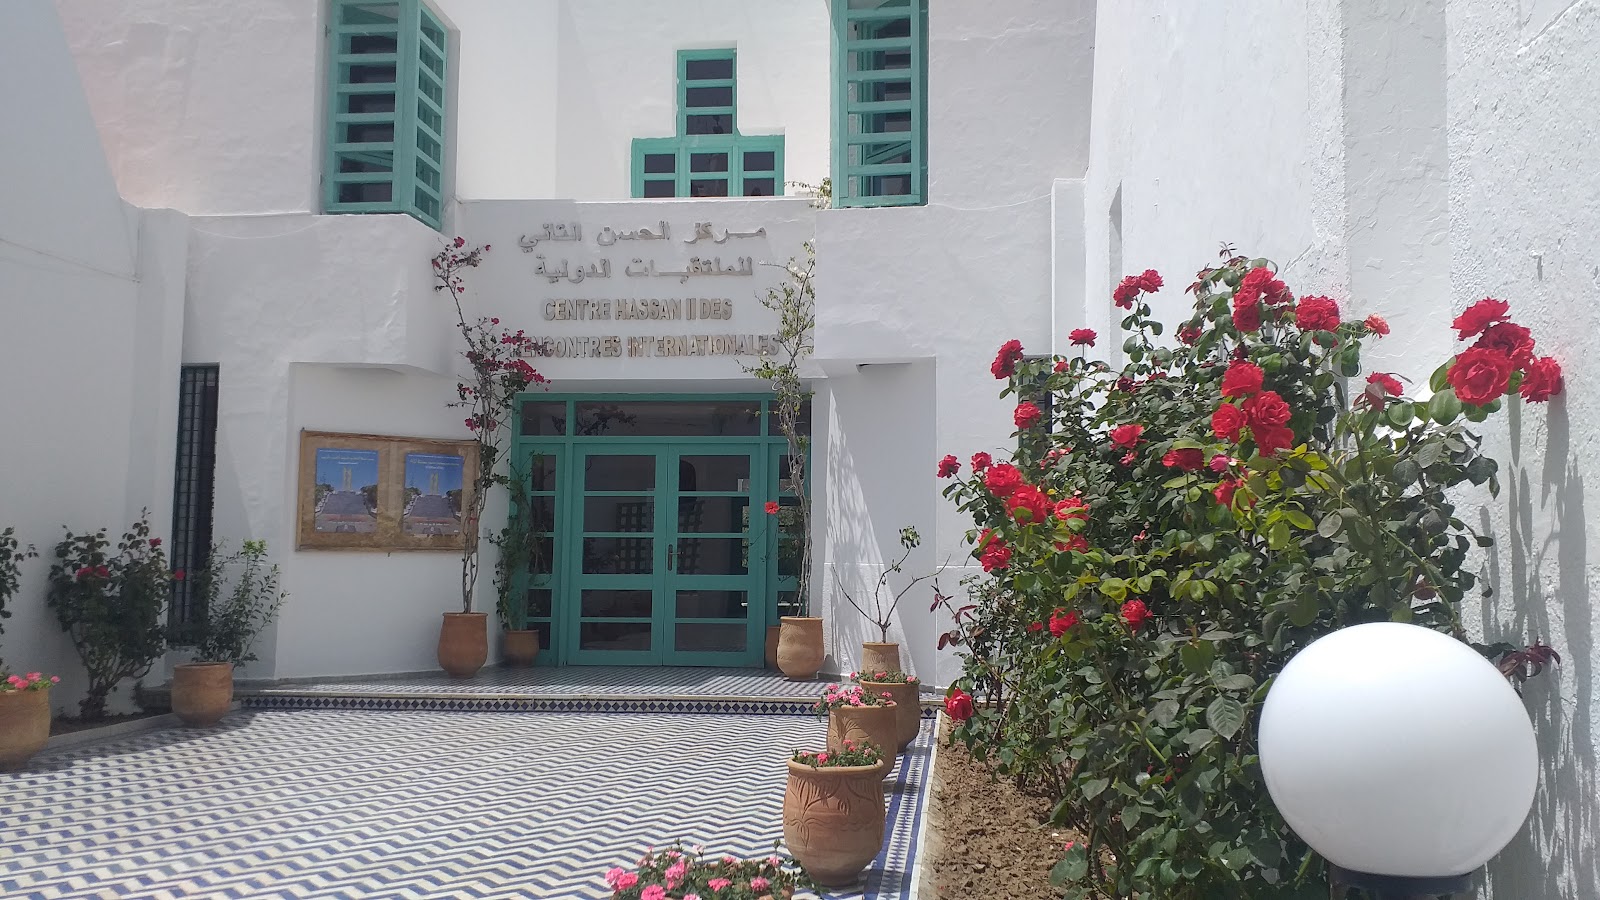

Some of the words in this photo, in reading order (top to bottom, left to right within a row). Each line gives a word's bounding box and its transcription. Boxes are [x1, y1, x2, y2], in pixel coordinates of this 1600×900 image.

[519, 223, 582, 254] الثاني
[597, 220, 671, 247] الحسن
[684, 221, 767, 245] مركز
[535, 254, 612, 284] الدولية
[625, 256, 753, 284] للملتقيات
[544, 298, 611, 321] CENTRE
[615, 298, 681, 320] HASSAN
[686, 298, 697, 321] II
[701, 298, 733, 320] DES
[628, 334, 780, 357] INTERNATIONALES
